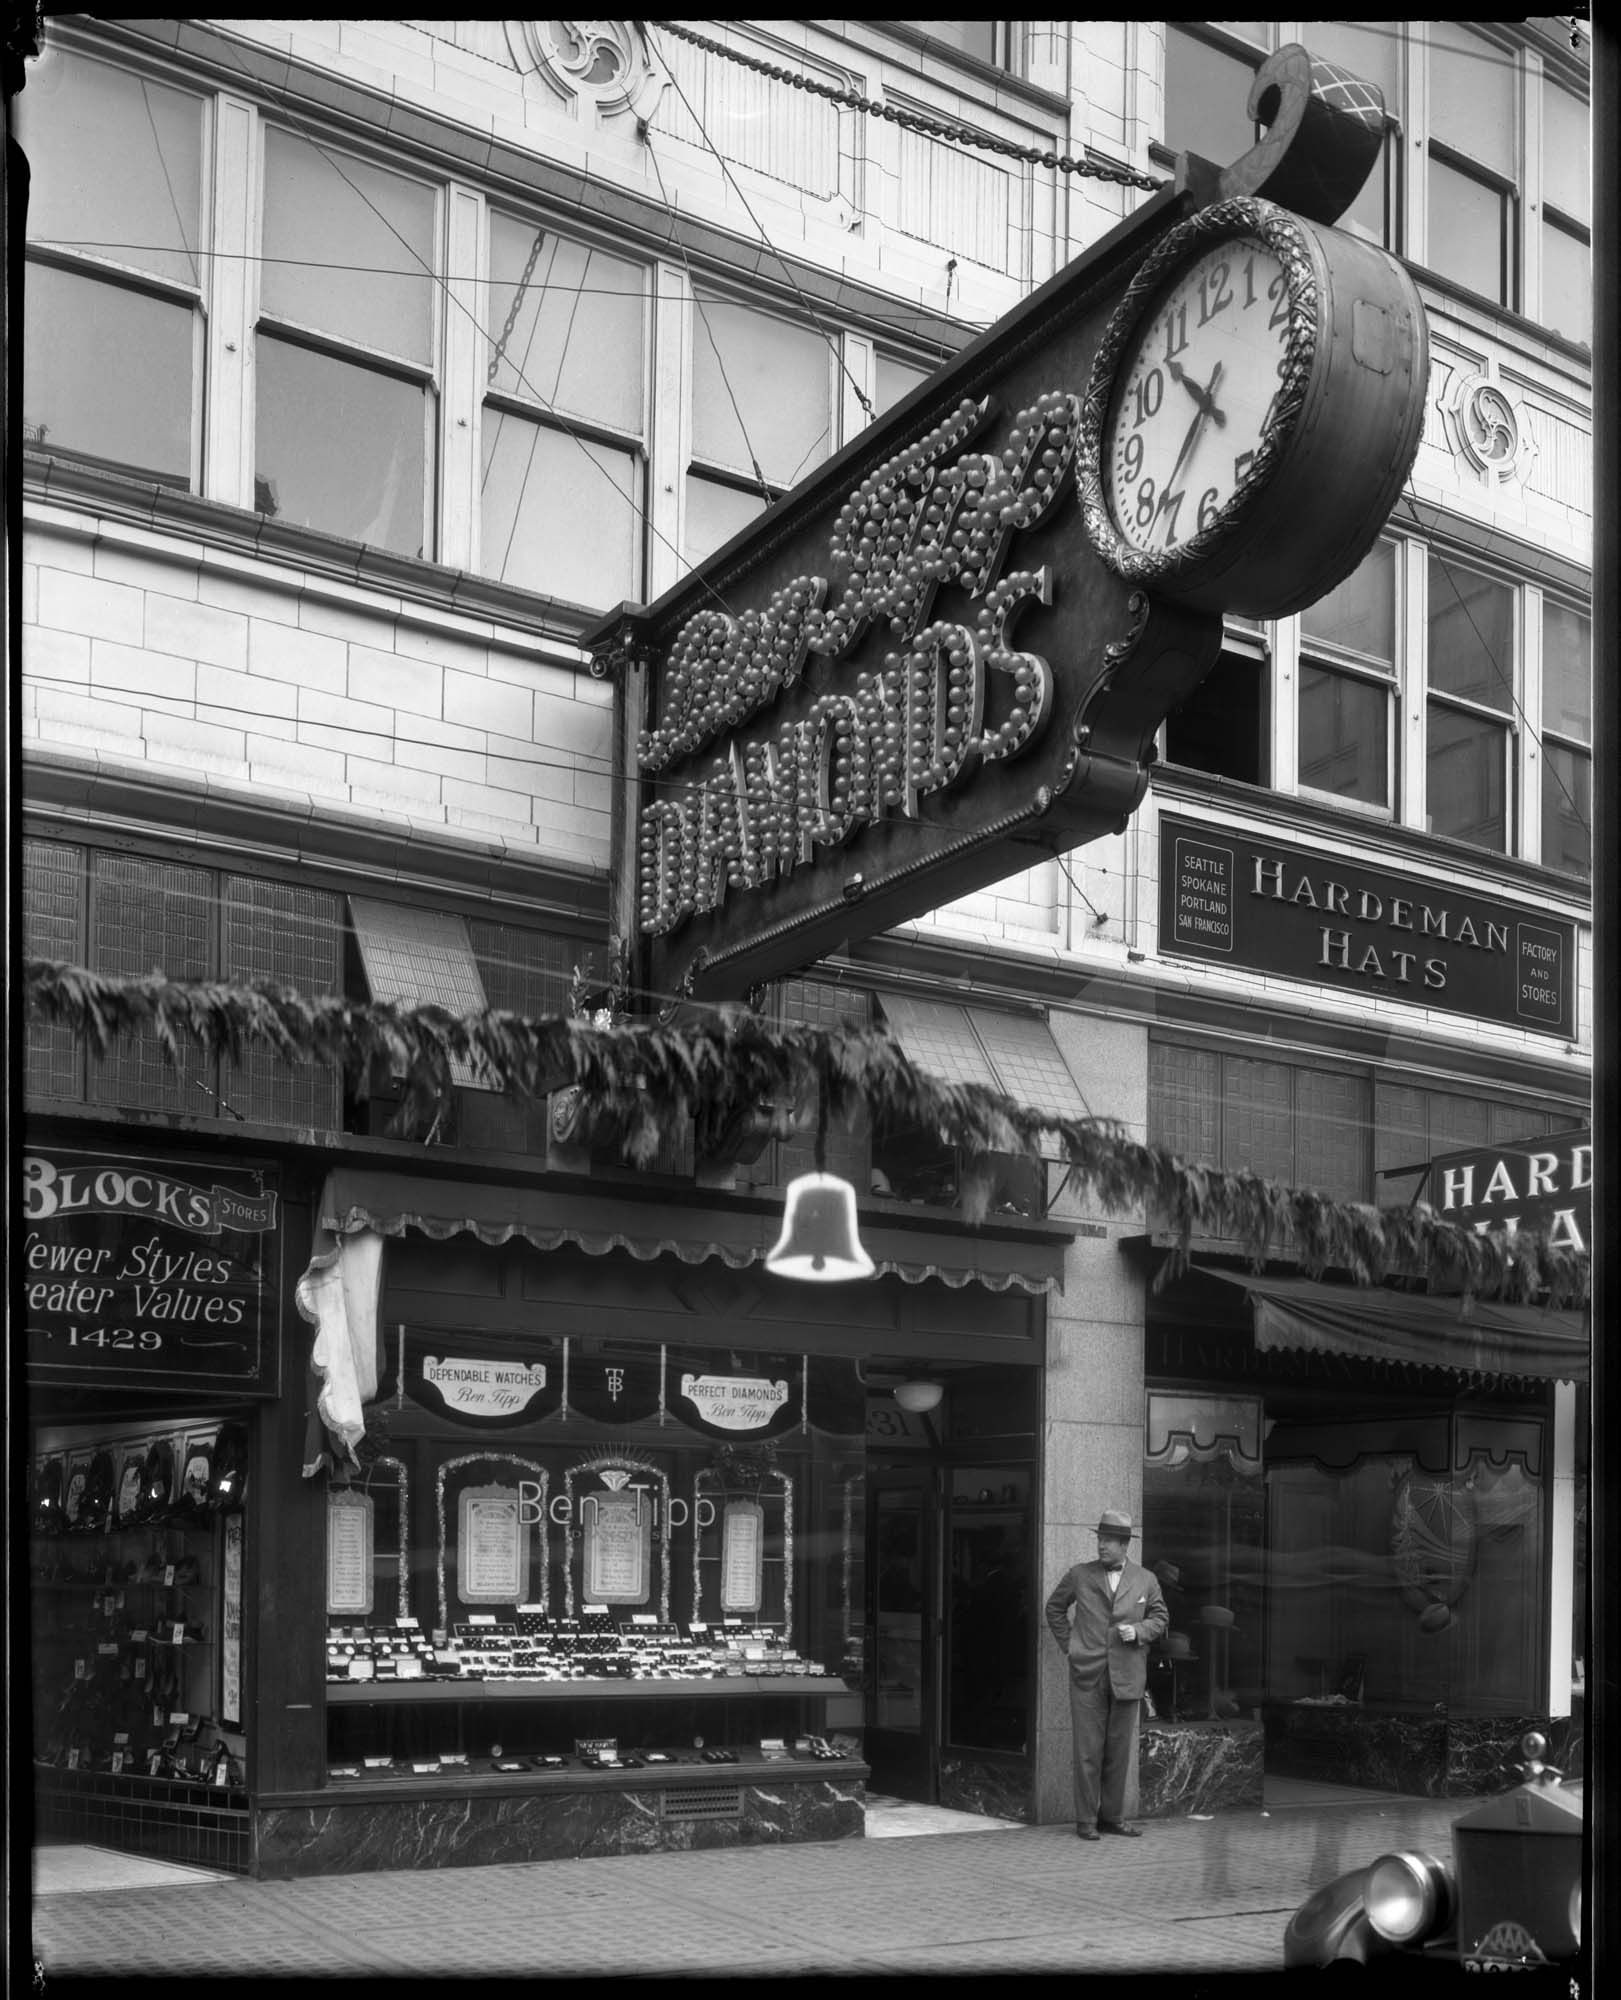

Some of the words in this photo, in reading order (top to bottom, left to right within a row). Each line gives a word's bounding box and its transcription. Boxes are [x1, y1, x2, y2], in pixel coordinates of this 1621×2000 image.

[1197, 260, 1234, 329] 12
[1163, 301, 1189, 361] 11
[1132, 368, 1164, 429] 10
[1123, 433, 1144, 483] 9
[1136, 477, 1155, 528] 8
[1160, 489, 1186, 546] 7
[640, 564, 1053, 937] DIAMONDS
[1184, 855, 1225, 876] SEATTLE
[1181, 874, 1227, 896] SPOKANE
[1181, 894, 1227, 915] PORTLAND
[1249, 855, 1511, 954] HARDEMAN
[1178, 913, 1192, 929] SAN
[1194, 917, 1230, 936] FRANCISCO
[1317, 926, 1449, 990] HATS
[1522, 941, 1558, 963] FACTORY
[1530, 967, 1550, 980] AND
[1522, 984, 1557, 1006] STORES
[221, 1202, 267, 1223] STORES
[116, 1236, 232, 1285] Styles
[133, 1284, 246, 1325] Values
[68, 1326, 162, 1351] 1429
[429, 1367, 490, 1384] DEPENDABLE
[494, 1371, 542, 1386] WATCHES
[452, 1386, 485, 1403] Ben
[488, 1388, 521, 1409] Tipp
[687, 1384, 726, 1398] PERFECT
[732, 1387, 783, 1401] DIAMONDS
[706, 1402, 736, 1417] Ben
[738, 1403, 767, 1423] Tipp
[517, 1480, 598, 1526] Ben
[628, 1483, 716, 1540] Tipp
